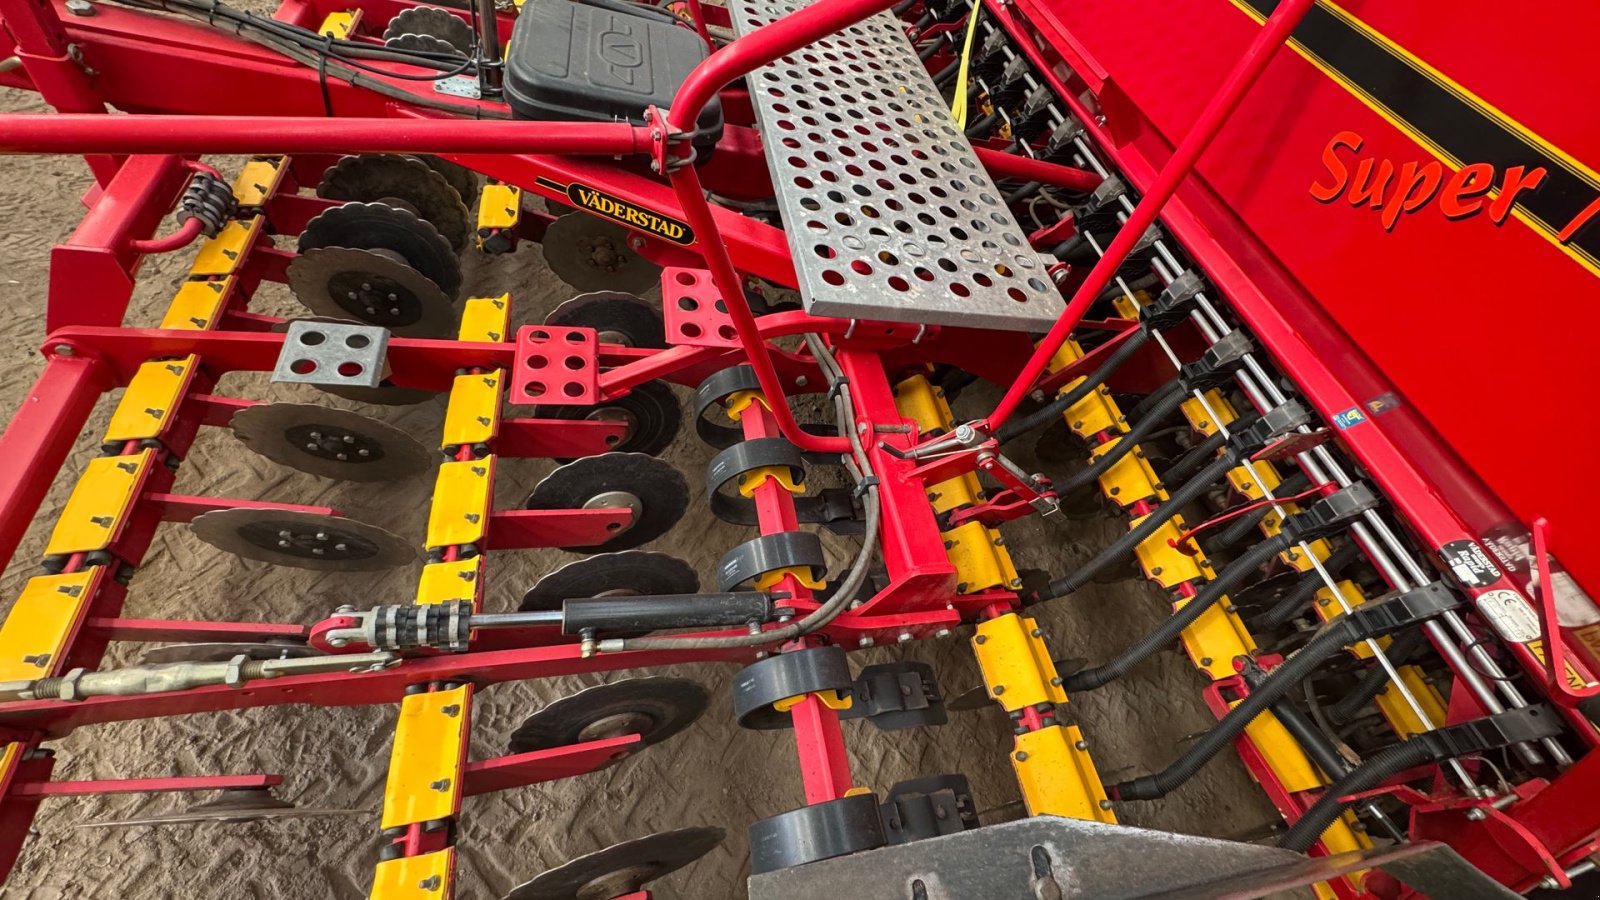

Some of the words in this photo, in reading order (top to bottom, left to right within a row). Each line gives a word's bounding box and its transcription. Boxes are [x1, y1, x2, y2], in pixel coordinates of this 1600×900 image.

[1308, 131, 1548, 232] Super
[577, 188, 684, 239] VÄDERSTAD
[1457, 550, 1485, 574] Rapid
[1497, 591, 1517, 607] CE
